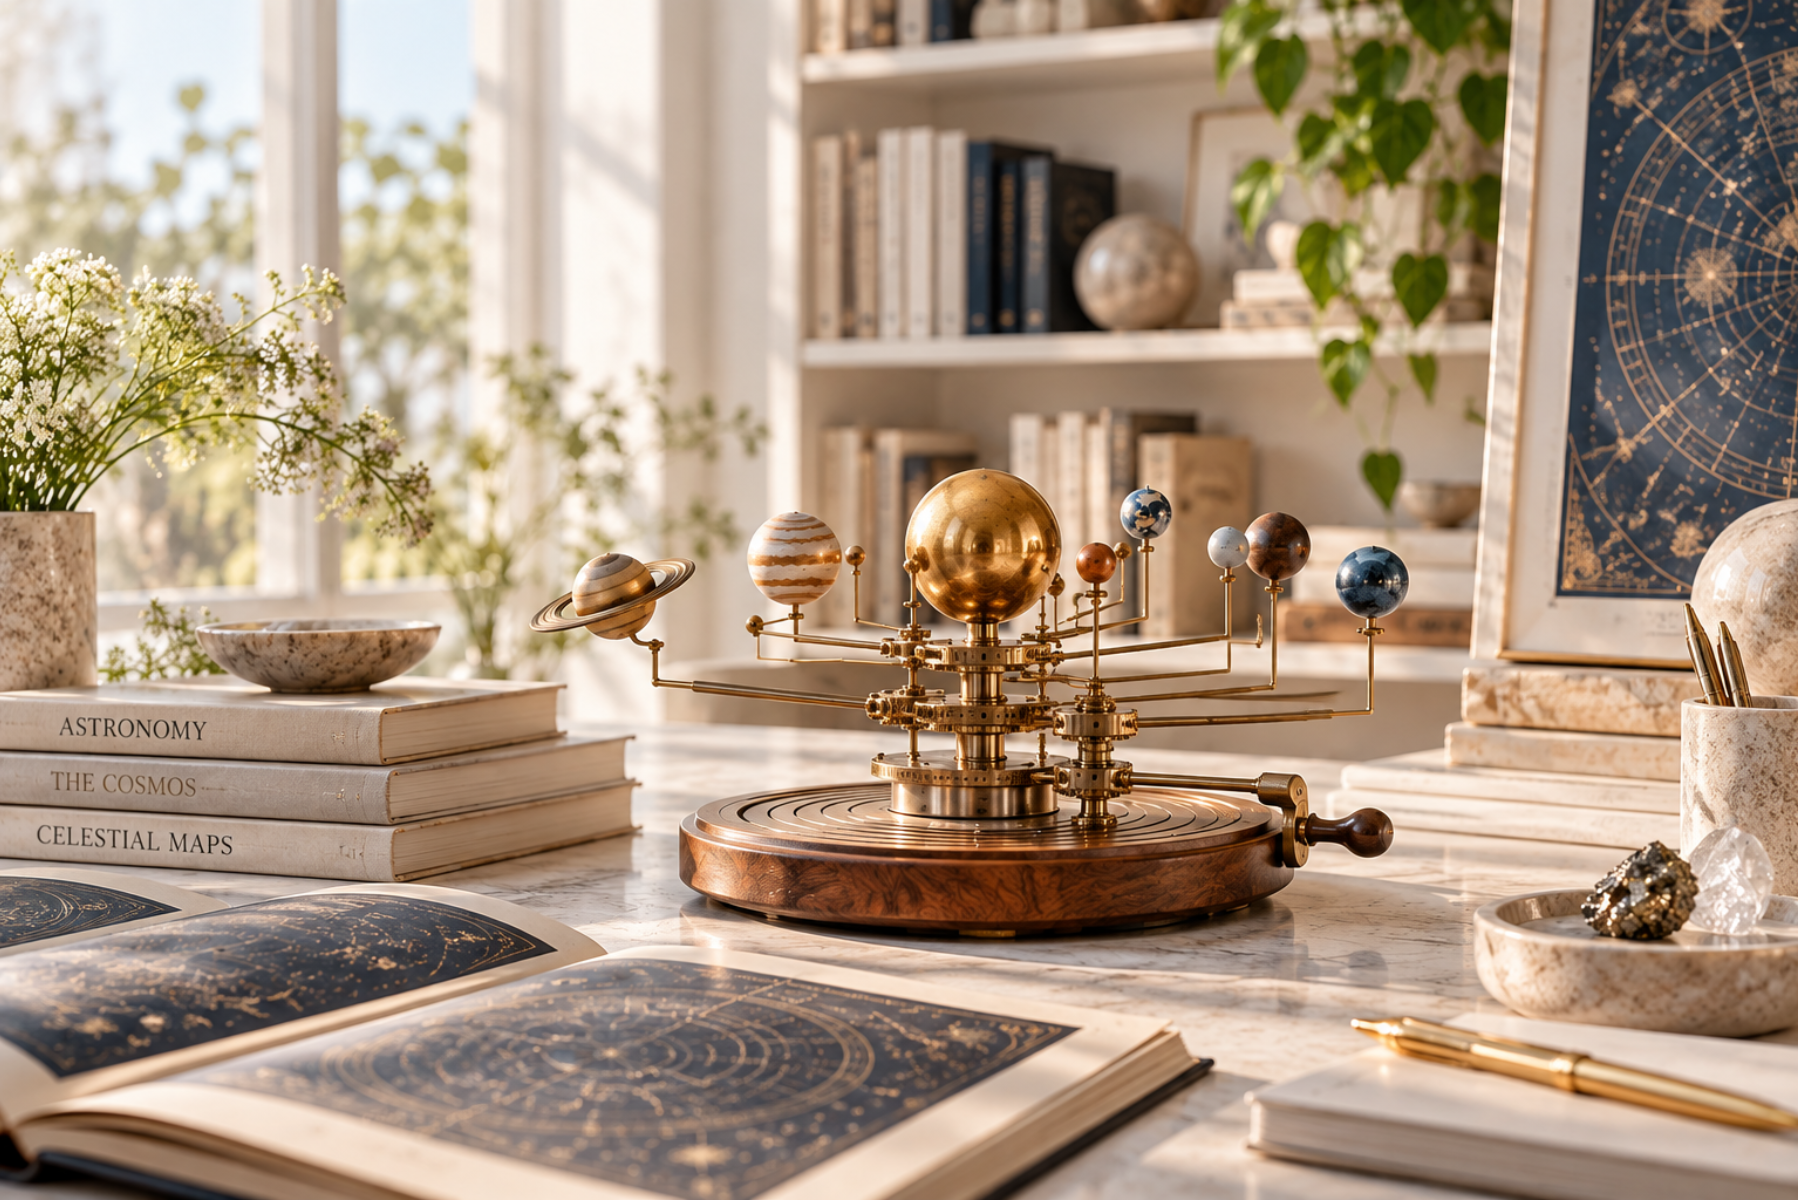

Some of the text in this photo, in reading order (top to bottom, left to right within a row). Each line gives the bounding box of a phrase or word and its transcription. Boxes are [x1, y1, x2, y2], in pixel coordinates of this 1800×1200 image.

[59, 717, 207, 741] ASTRONOMY
[50, 771, 197, 797] THE COSMOS
[36, 824, 233, 855] CELESTIAL MAPS
